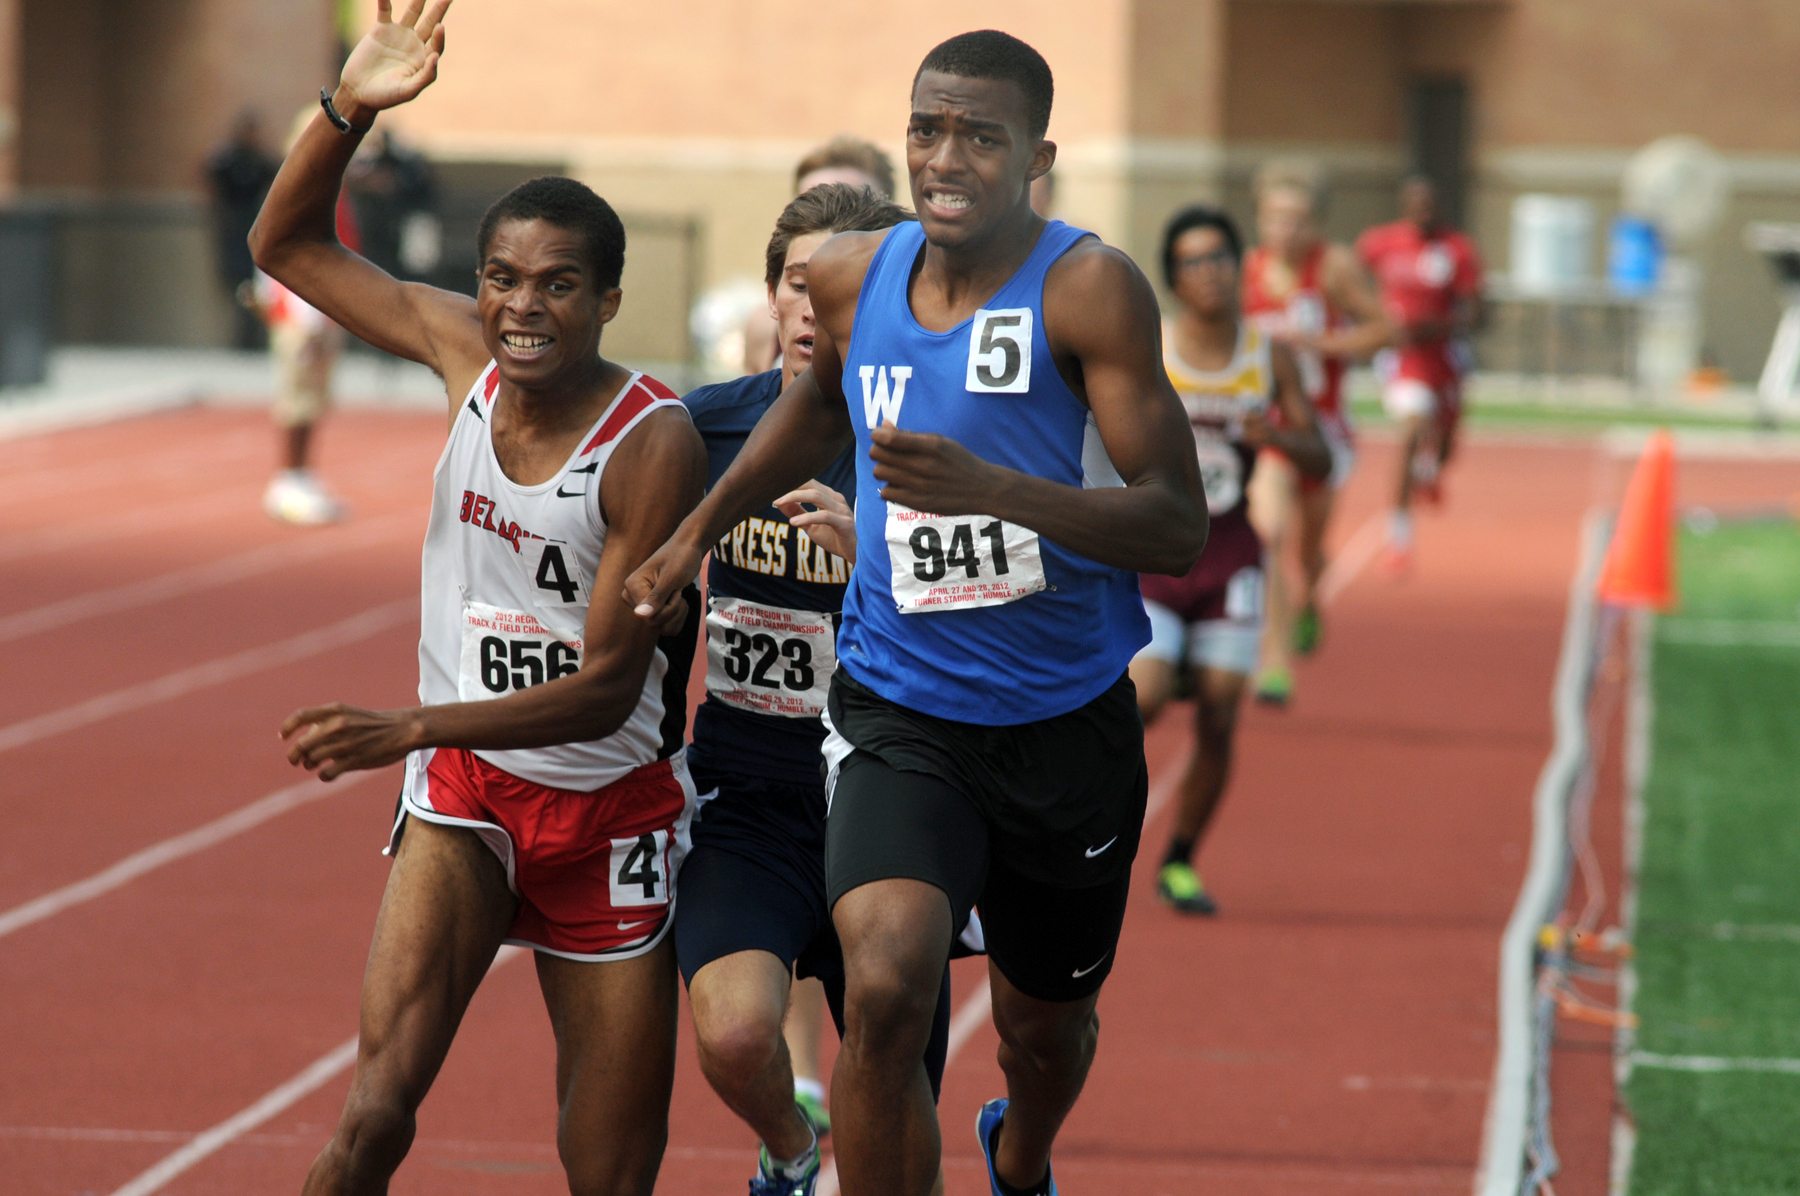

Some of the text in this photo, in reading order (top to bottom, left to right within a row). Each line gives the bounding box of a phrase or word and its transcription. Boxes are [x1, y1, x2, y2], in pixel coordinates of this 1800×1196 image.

[976, 315, 1022, 388] 5
[858, 365, 913, 430] W
[896, 510, 919, 521] TRACK
[921, 511, 927, 520] &
[909, 520, 1010, 582] 941
[535, 544, 579, 603] 4
[914, 597, 942, 606] TURNER
[944, 593, 976, 604] STADIUM
[983, 590, 1015, 599] HUMBLE,
[1016, 587, 1027, 595] TX
[928, 582, 1009, 596] APRIL 27 AND 28, 2012
[468, 615, 490, 628] TRACK
[491, 621, 497, 630] &
[499, 622, 521, 633] FIELD
[495, 612, 513, 622] 2012
[718, 609, 734, 620] TRACK
[740, 615, 761, 627] FIELD
[762, 620, 825, 634] CHAMPIONSHIPS
[737, 604, 792, 622] 2012 REGION III
[480, 635, 580, 693] 656
[724, 628, 815, 691] 323
[721, 692, 744, 704] TURNER
[744, 697, 771, 710] STADIUM
[809, 706, 820, 714] TX
[733, 687, 749, 698] APRIL
[759, 692, 773, 701] AND
[786, 697, 804, 705] 2012
[617, 832, 660, 899] 4
